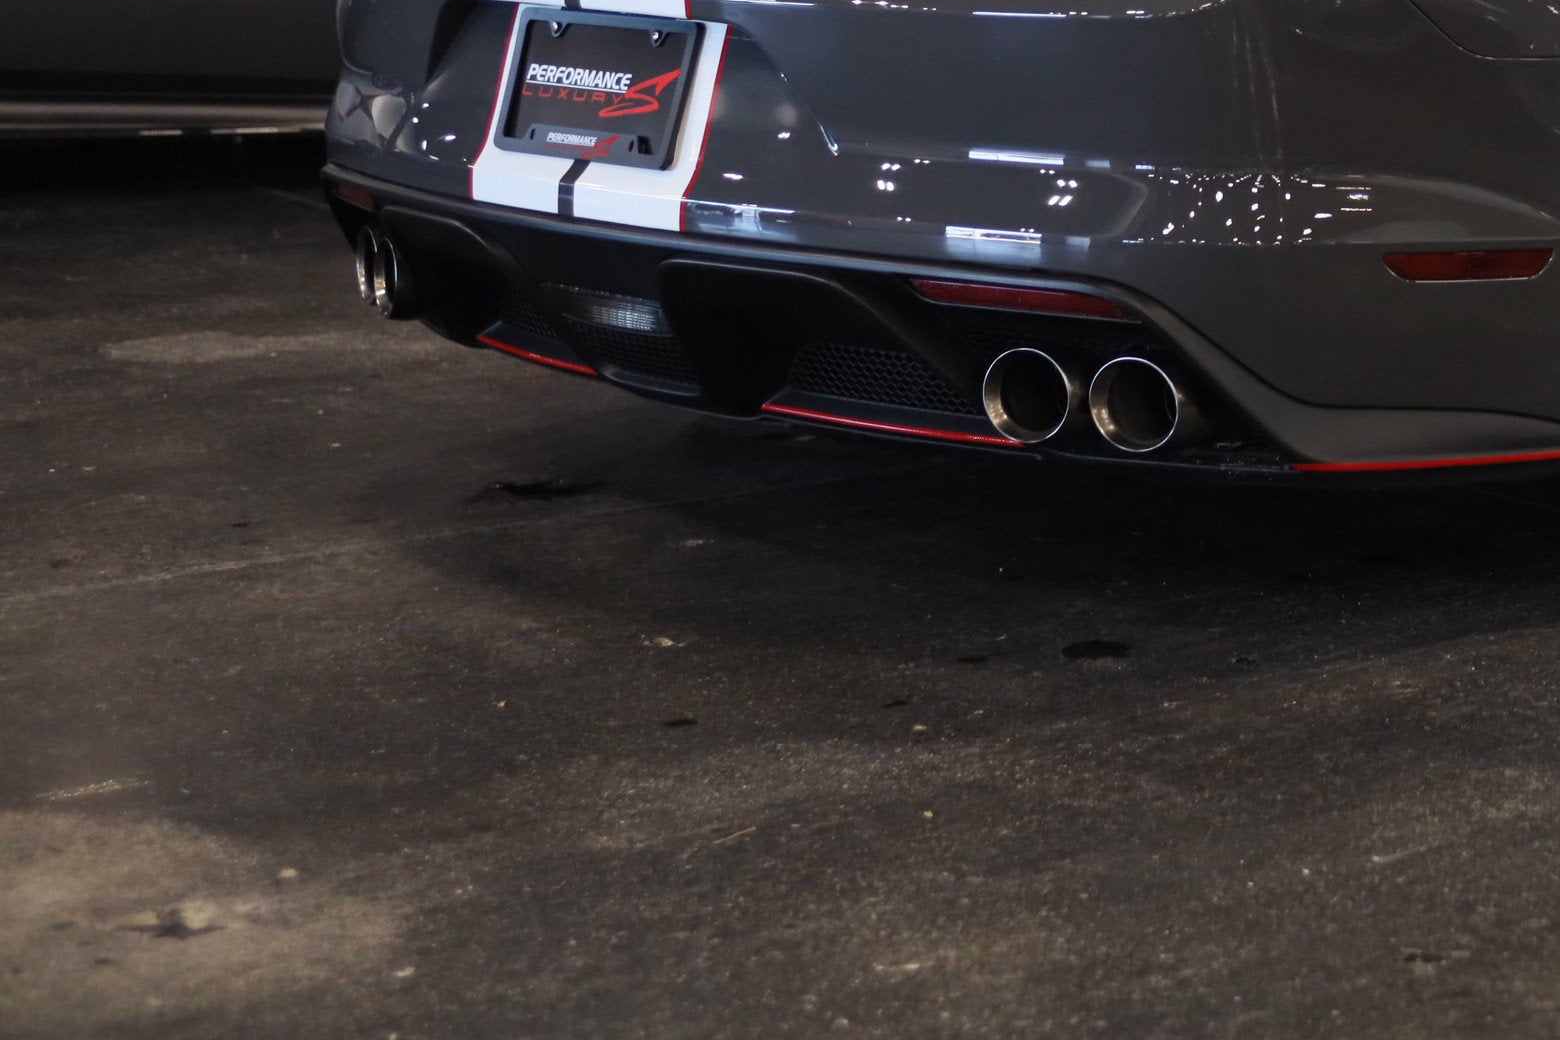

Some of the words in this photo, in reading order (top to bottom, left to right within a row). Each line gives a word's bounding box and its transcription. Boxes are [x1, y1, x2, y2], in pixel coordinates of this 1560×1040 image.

[527, 63, 633, 91] PERFORMANCE
[522, 84, 626, 104] LUXURY
[546, 132, 598, 145] PERFORMANCE
